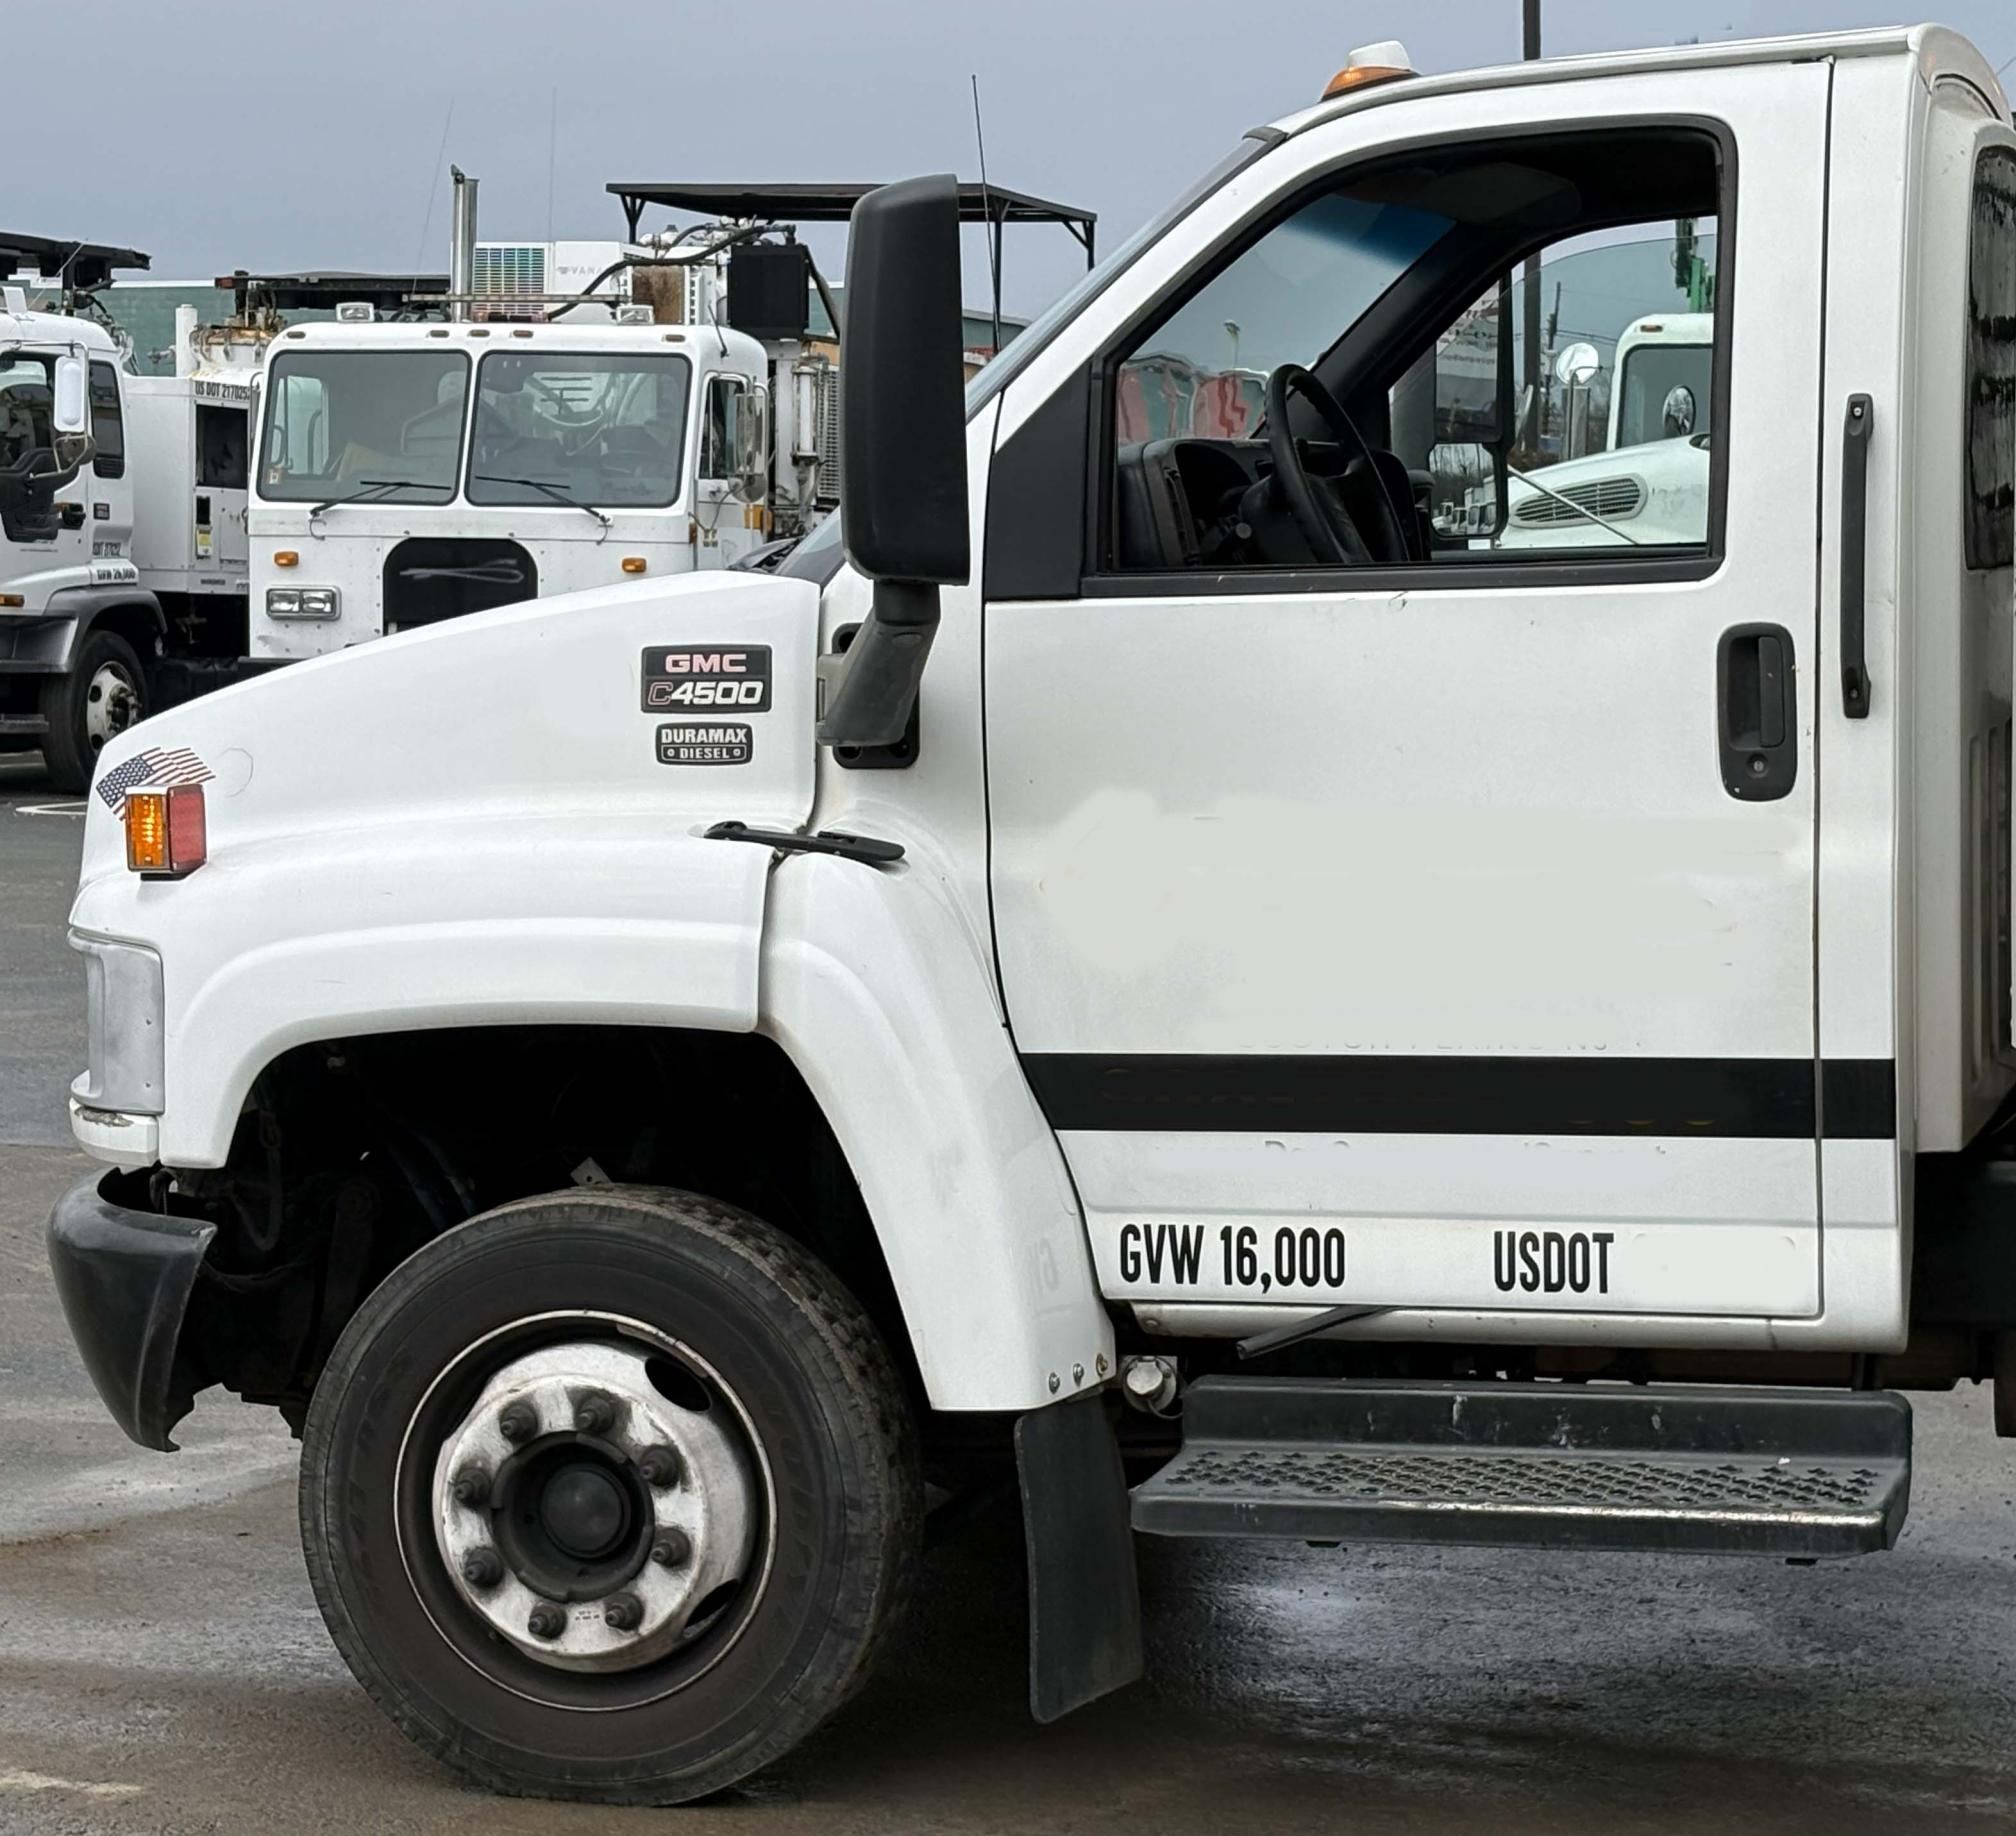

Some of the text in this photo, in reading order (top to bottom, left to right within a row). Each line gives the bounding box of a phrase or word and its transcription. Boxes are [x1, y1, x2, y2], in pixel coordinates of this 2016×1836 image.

[195, 380, 205, 395] US
[206, 382, 220, 397] DOT
[665, 653, 747, 673] GMC
[647, 681, 764, 705] C4500
[661, 728, 748, 744] DURAMAX
[680, 747, 730, 759] DIESEL
[1120, 1224, 1345, 1294] GVW 16,000
[1494, 1231, 1615, 1294] USDOT
